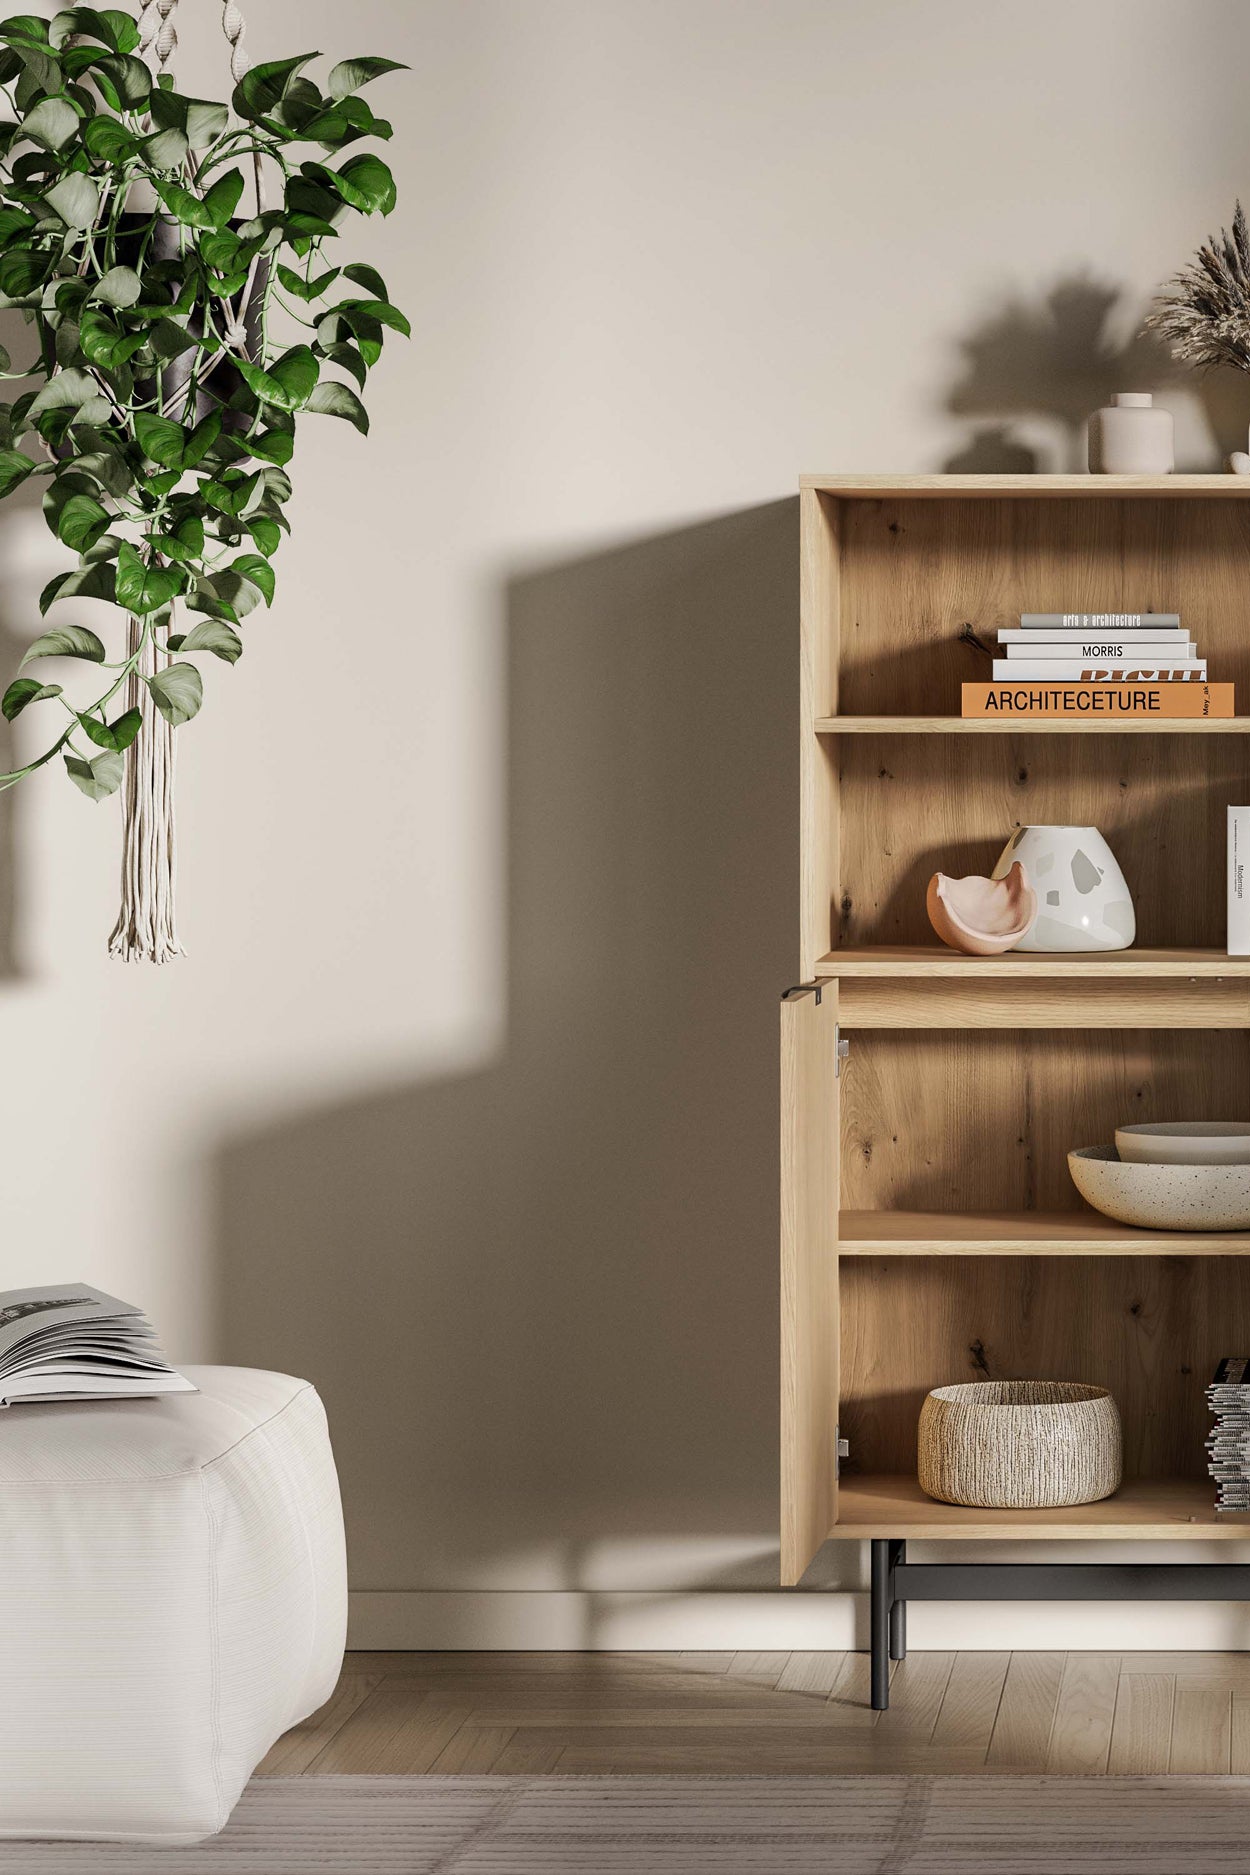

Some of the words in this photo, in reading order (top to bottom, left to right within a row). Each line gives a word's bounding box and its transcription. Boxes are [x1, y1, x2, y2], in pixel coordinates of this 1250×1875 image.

[1063, 614, 1079, 627] arts
[1092, 614, 1141, 627] architecture
[1082, 645, 1123, 657] MORRIS
[985, 691, 1160, 710] ARCHITECETURE
